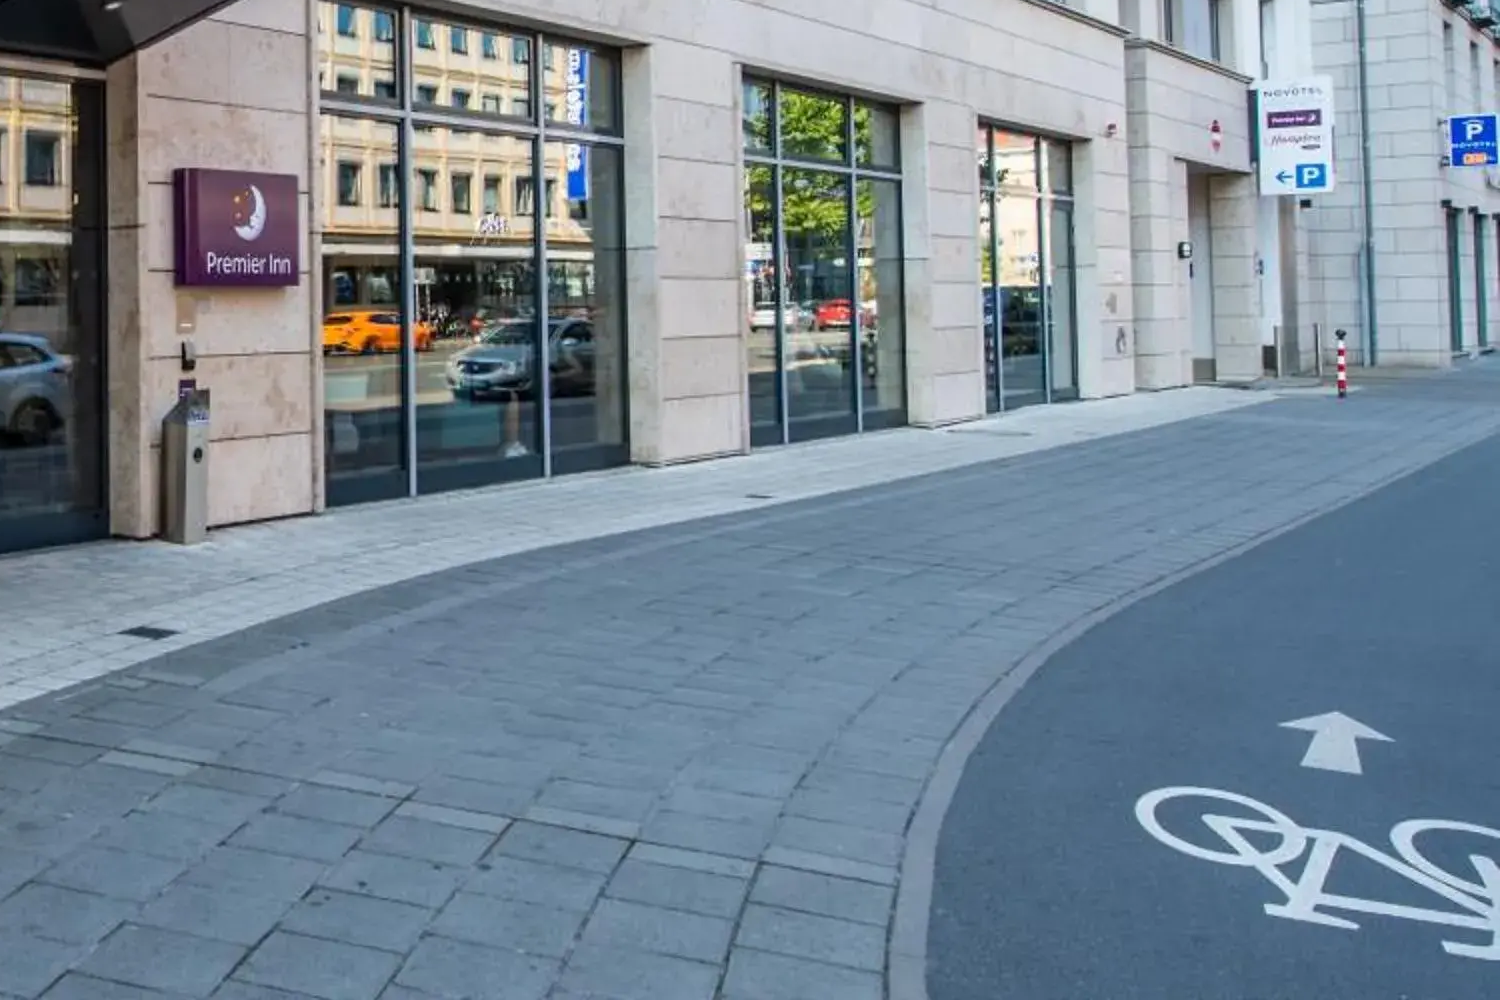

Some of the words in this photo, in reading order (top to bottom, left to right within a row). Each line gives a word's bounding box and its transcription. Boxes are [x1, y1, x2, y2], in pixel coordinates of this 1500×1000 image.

[1263, 86, 1324, 98] NOVOTEL
[1303, 166, 1321, 185] P
[206, 251, 268, 275] Premier
[269, 252, 292, 275] Inn
